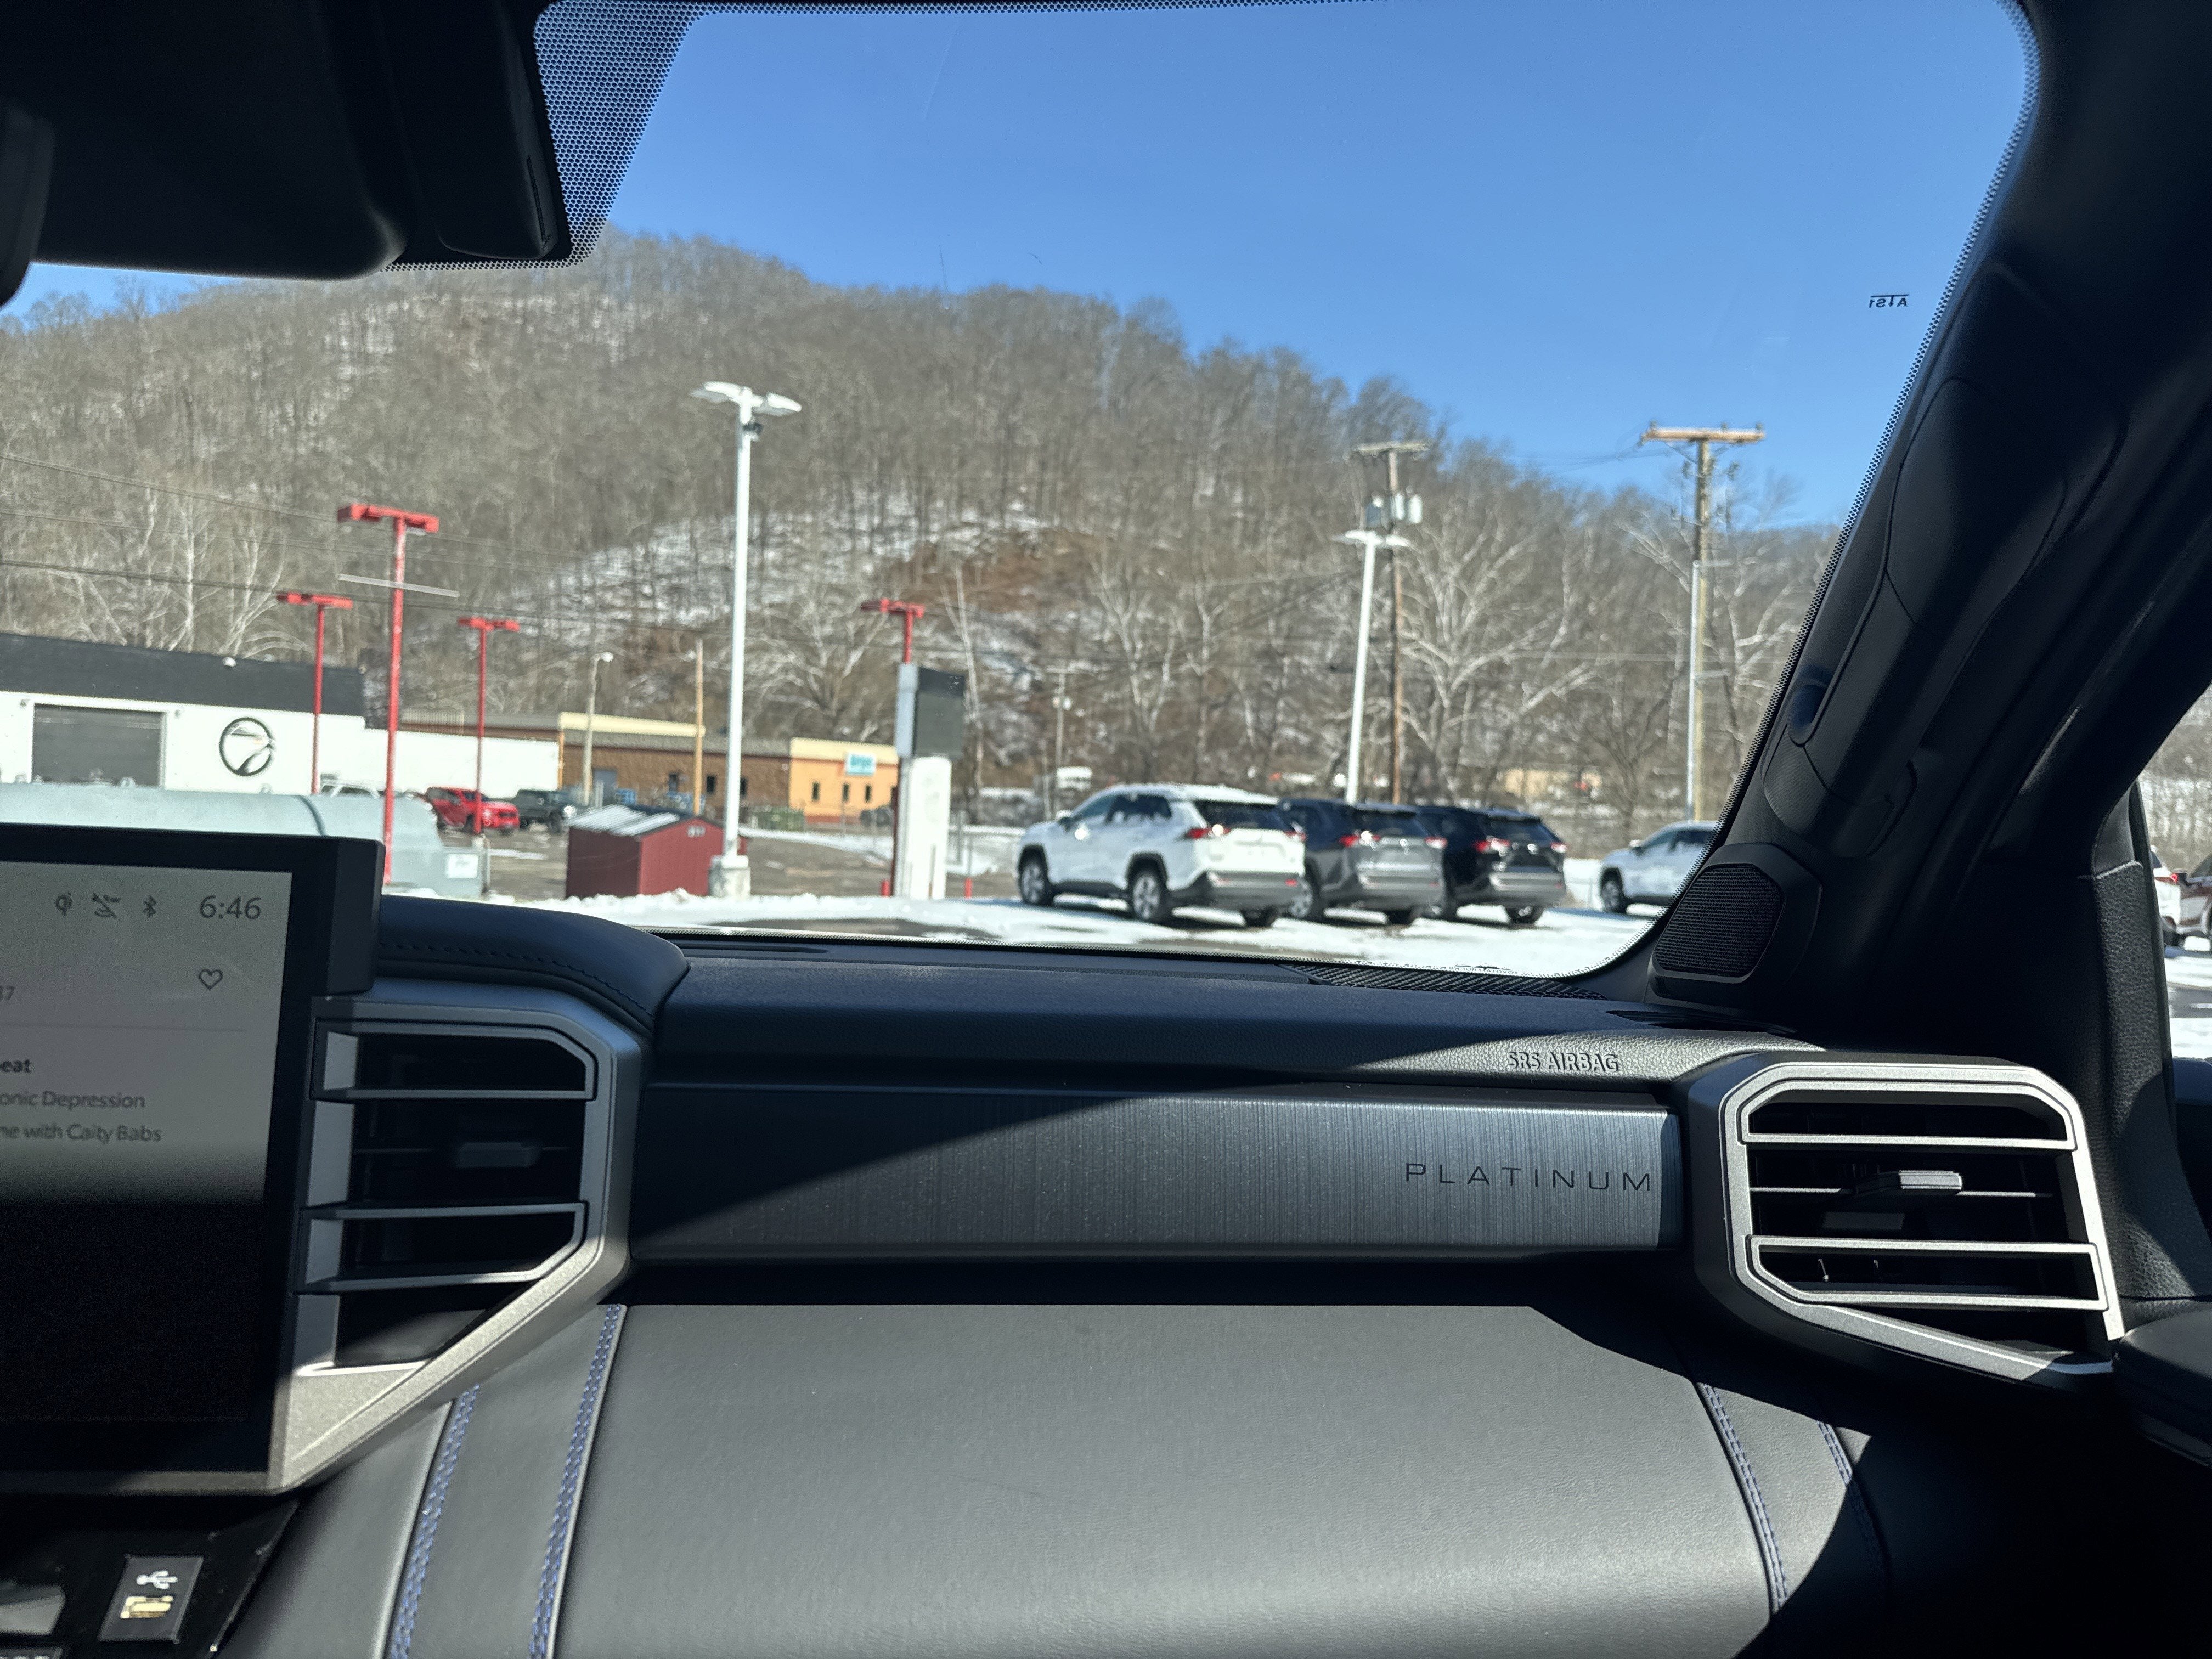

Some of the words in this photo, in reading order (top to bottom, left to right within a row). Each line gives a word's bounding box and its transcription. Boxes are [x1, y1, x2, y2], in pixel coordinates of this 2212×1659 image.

[200, 895, 261, 920] 6:46
[1508, 1051, 1541, 1069] SRS
[1547, 1051, 1618, 1072] AIRBAG
[43, 1091, 146, 1110] Depression
[24, 1123, 64, 1140] with
[66, 1124, 114, 1145] Caity
[116, 1125, 164, 1142] Babs
[1405, 1163, 1651, 1192] PLATINUM
